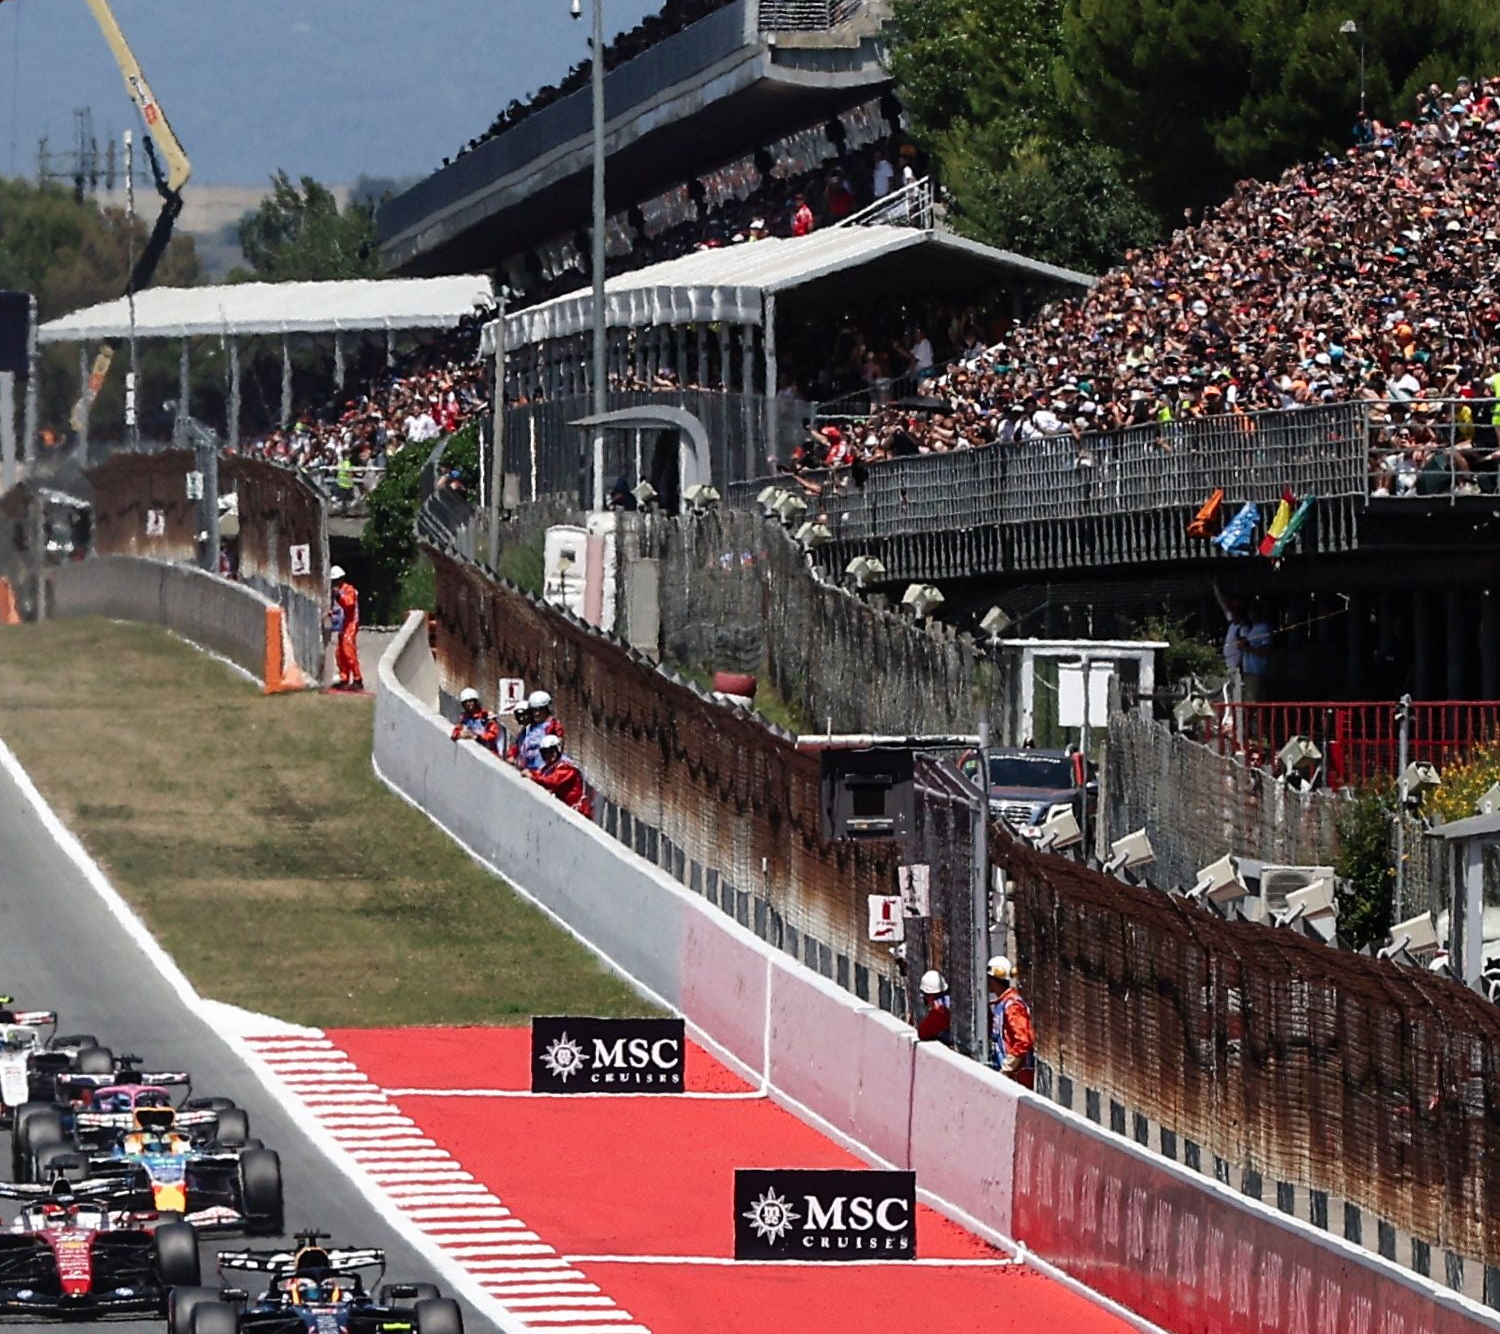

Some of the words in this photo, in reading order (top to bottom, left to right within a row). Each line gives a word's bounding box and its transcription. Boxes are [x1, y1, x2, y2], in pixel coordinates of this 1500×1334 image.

[591, 1038, 679, 1069] MSC
[802, 1194, 909, 1232] MSC
[802, 1236, 909, 1250] CRUISES
